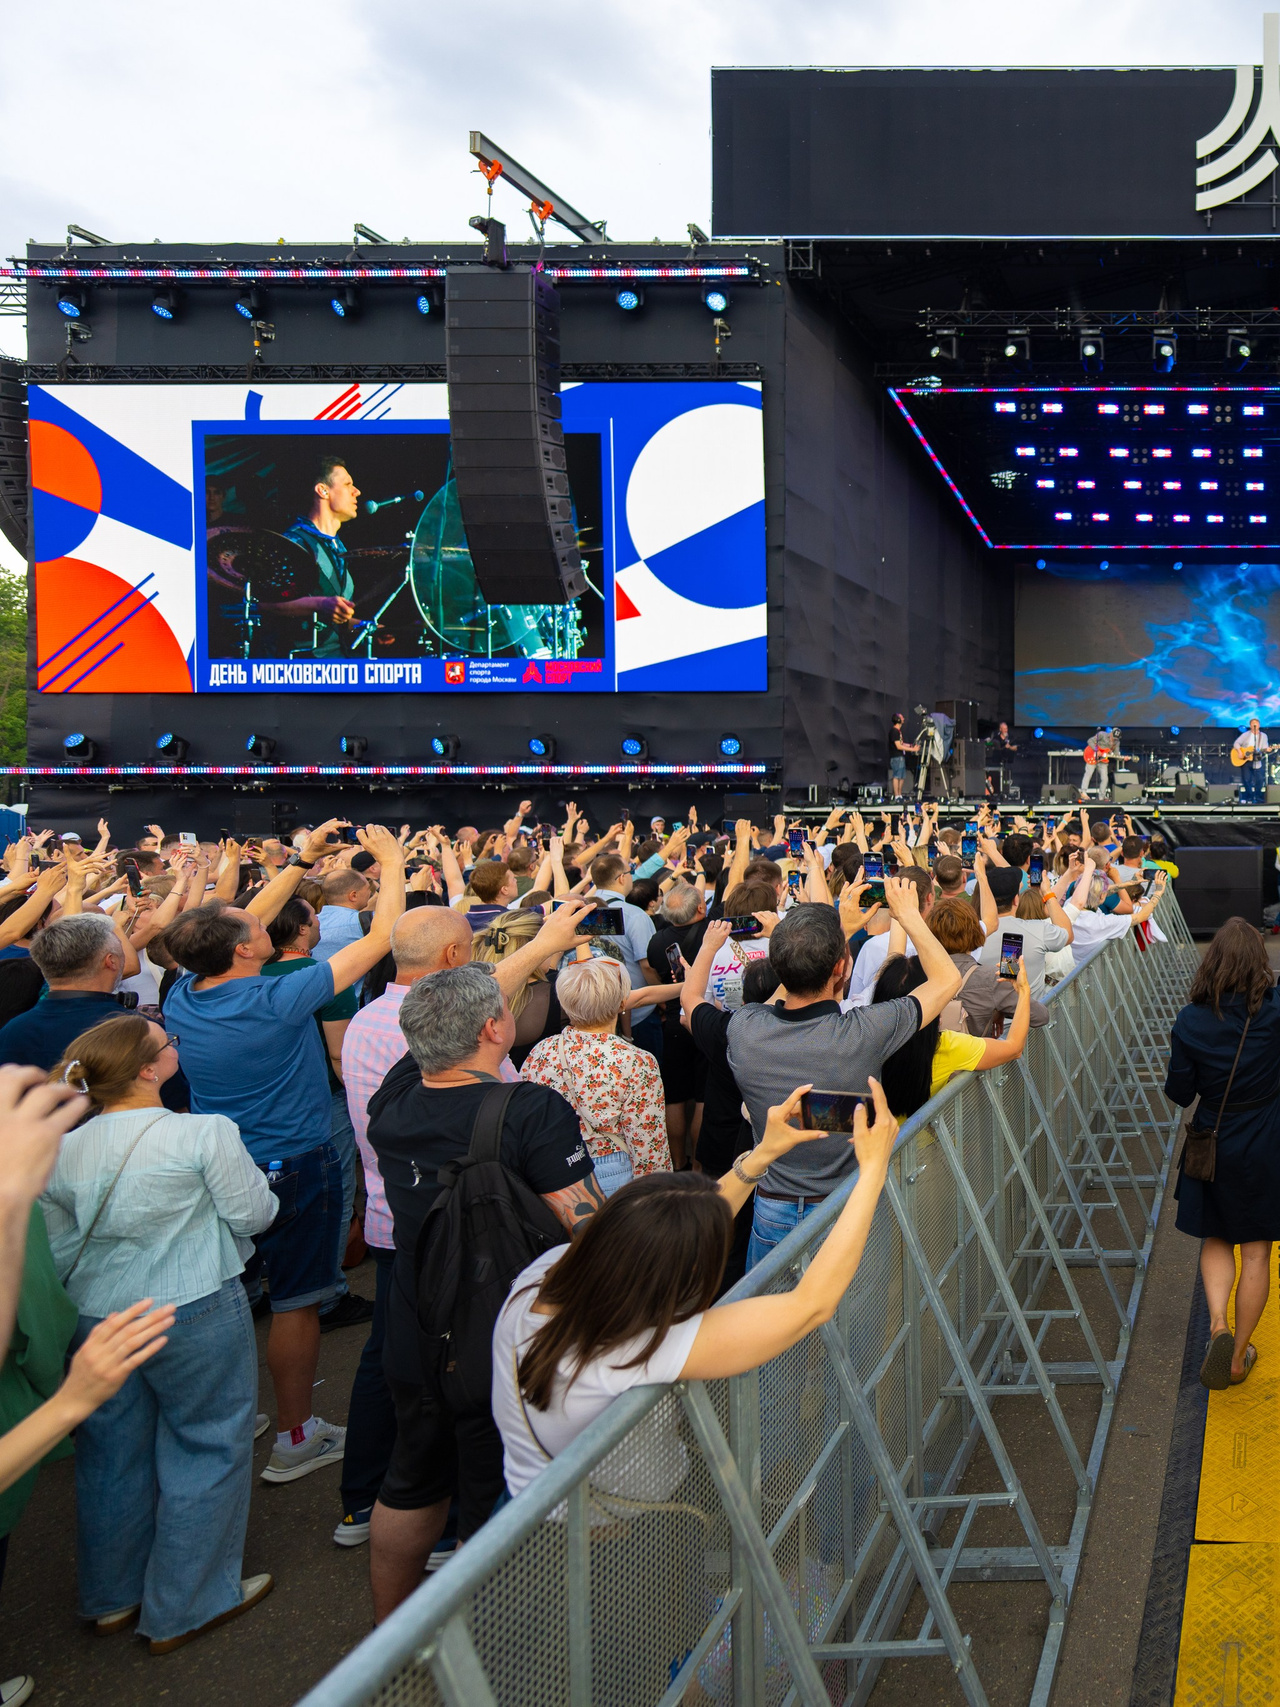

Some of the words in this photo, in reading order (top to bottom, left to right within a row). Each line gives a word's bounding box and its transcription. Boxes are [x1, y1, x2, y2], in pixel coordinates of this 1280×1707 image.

[469, 661, 510, 669] Департамент
[209, 663, 247, 686] ДЕНЬ
[252, 663, 358, 684] МОСКОВСКОГО
[364, 663, 422, 684] СПОРТА
